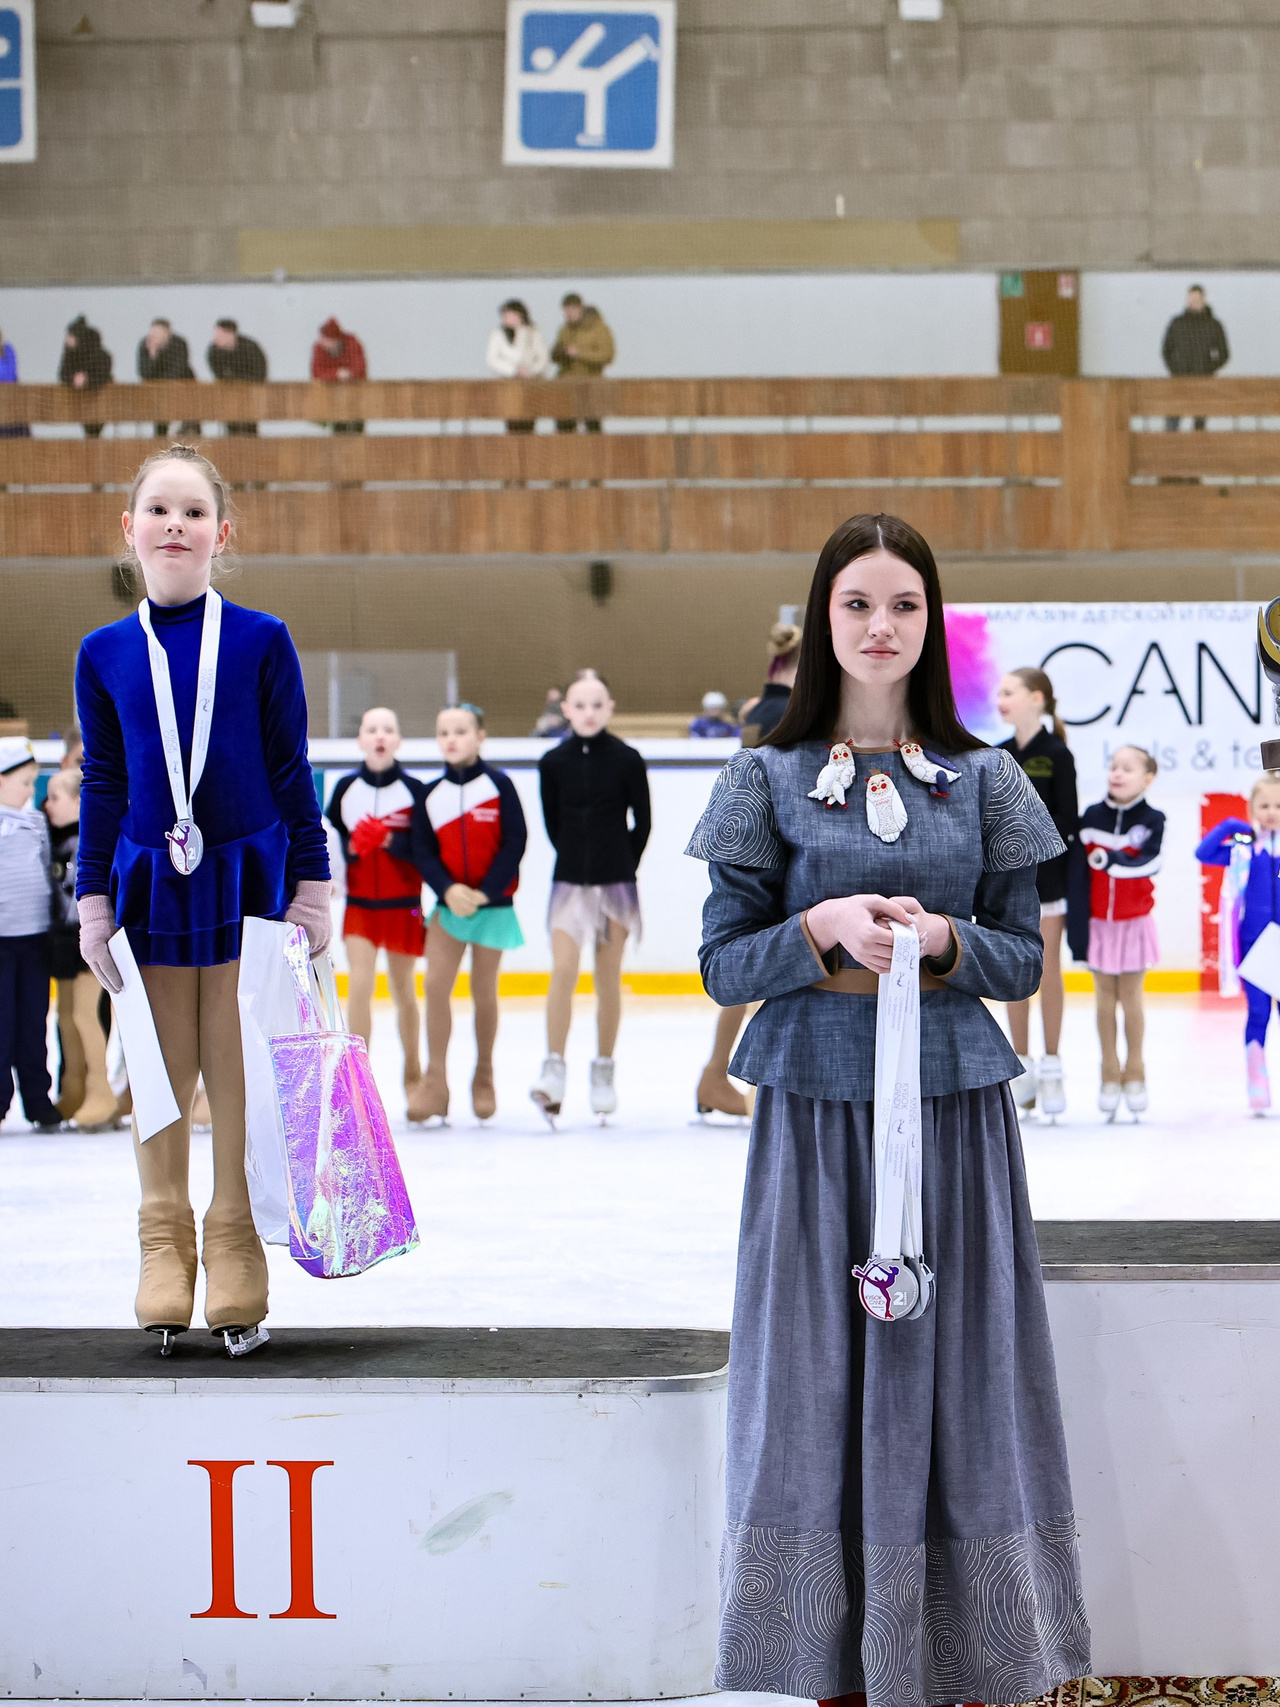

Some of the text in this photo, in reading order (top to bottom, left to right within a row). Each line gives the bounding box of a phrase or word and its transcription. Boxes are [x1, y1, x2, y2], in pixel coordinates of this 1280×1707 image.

[1040, 641, 1263, 726] CAN
[894, 936, 903, 964] CANDY
[903, 936, 911, 963] КУБОК
[894, 1082, 902, 1110] CANDY
[893, 1291, 904, 1306] 2
[187, 1460, 337, 1619] II
